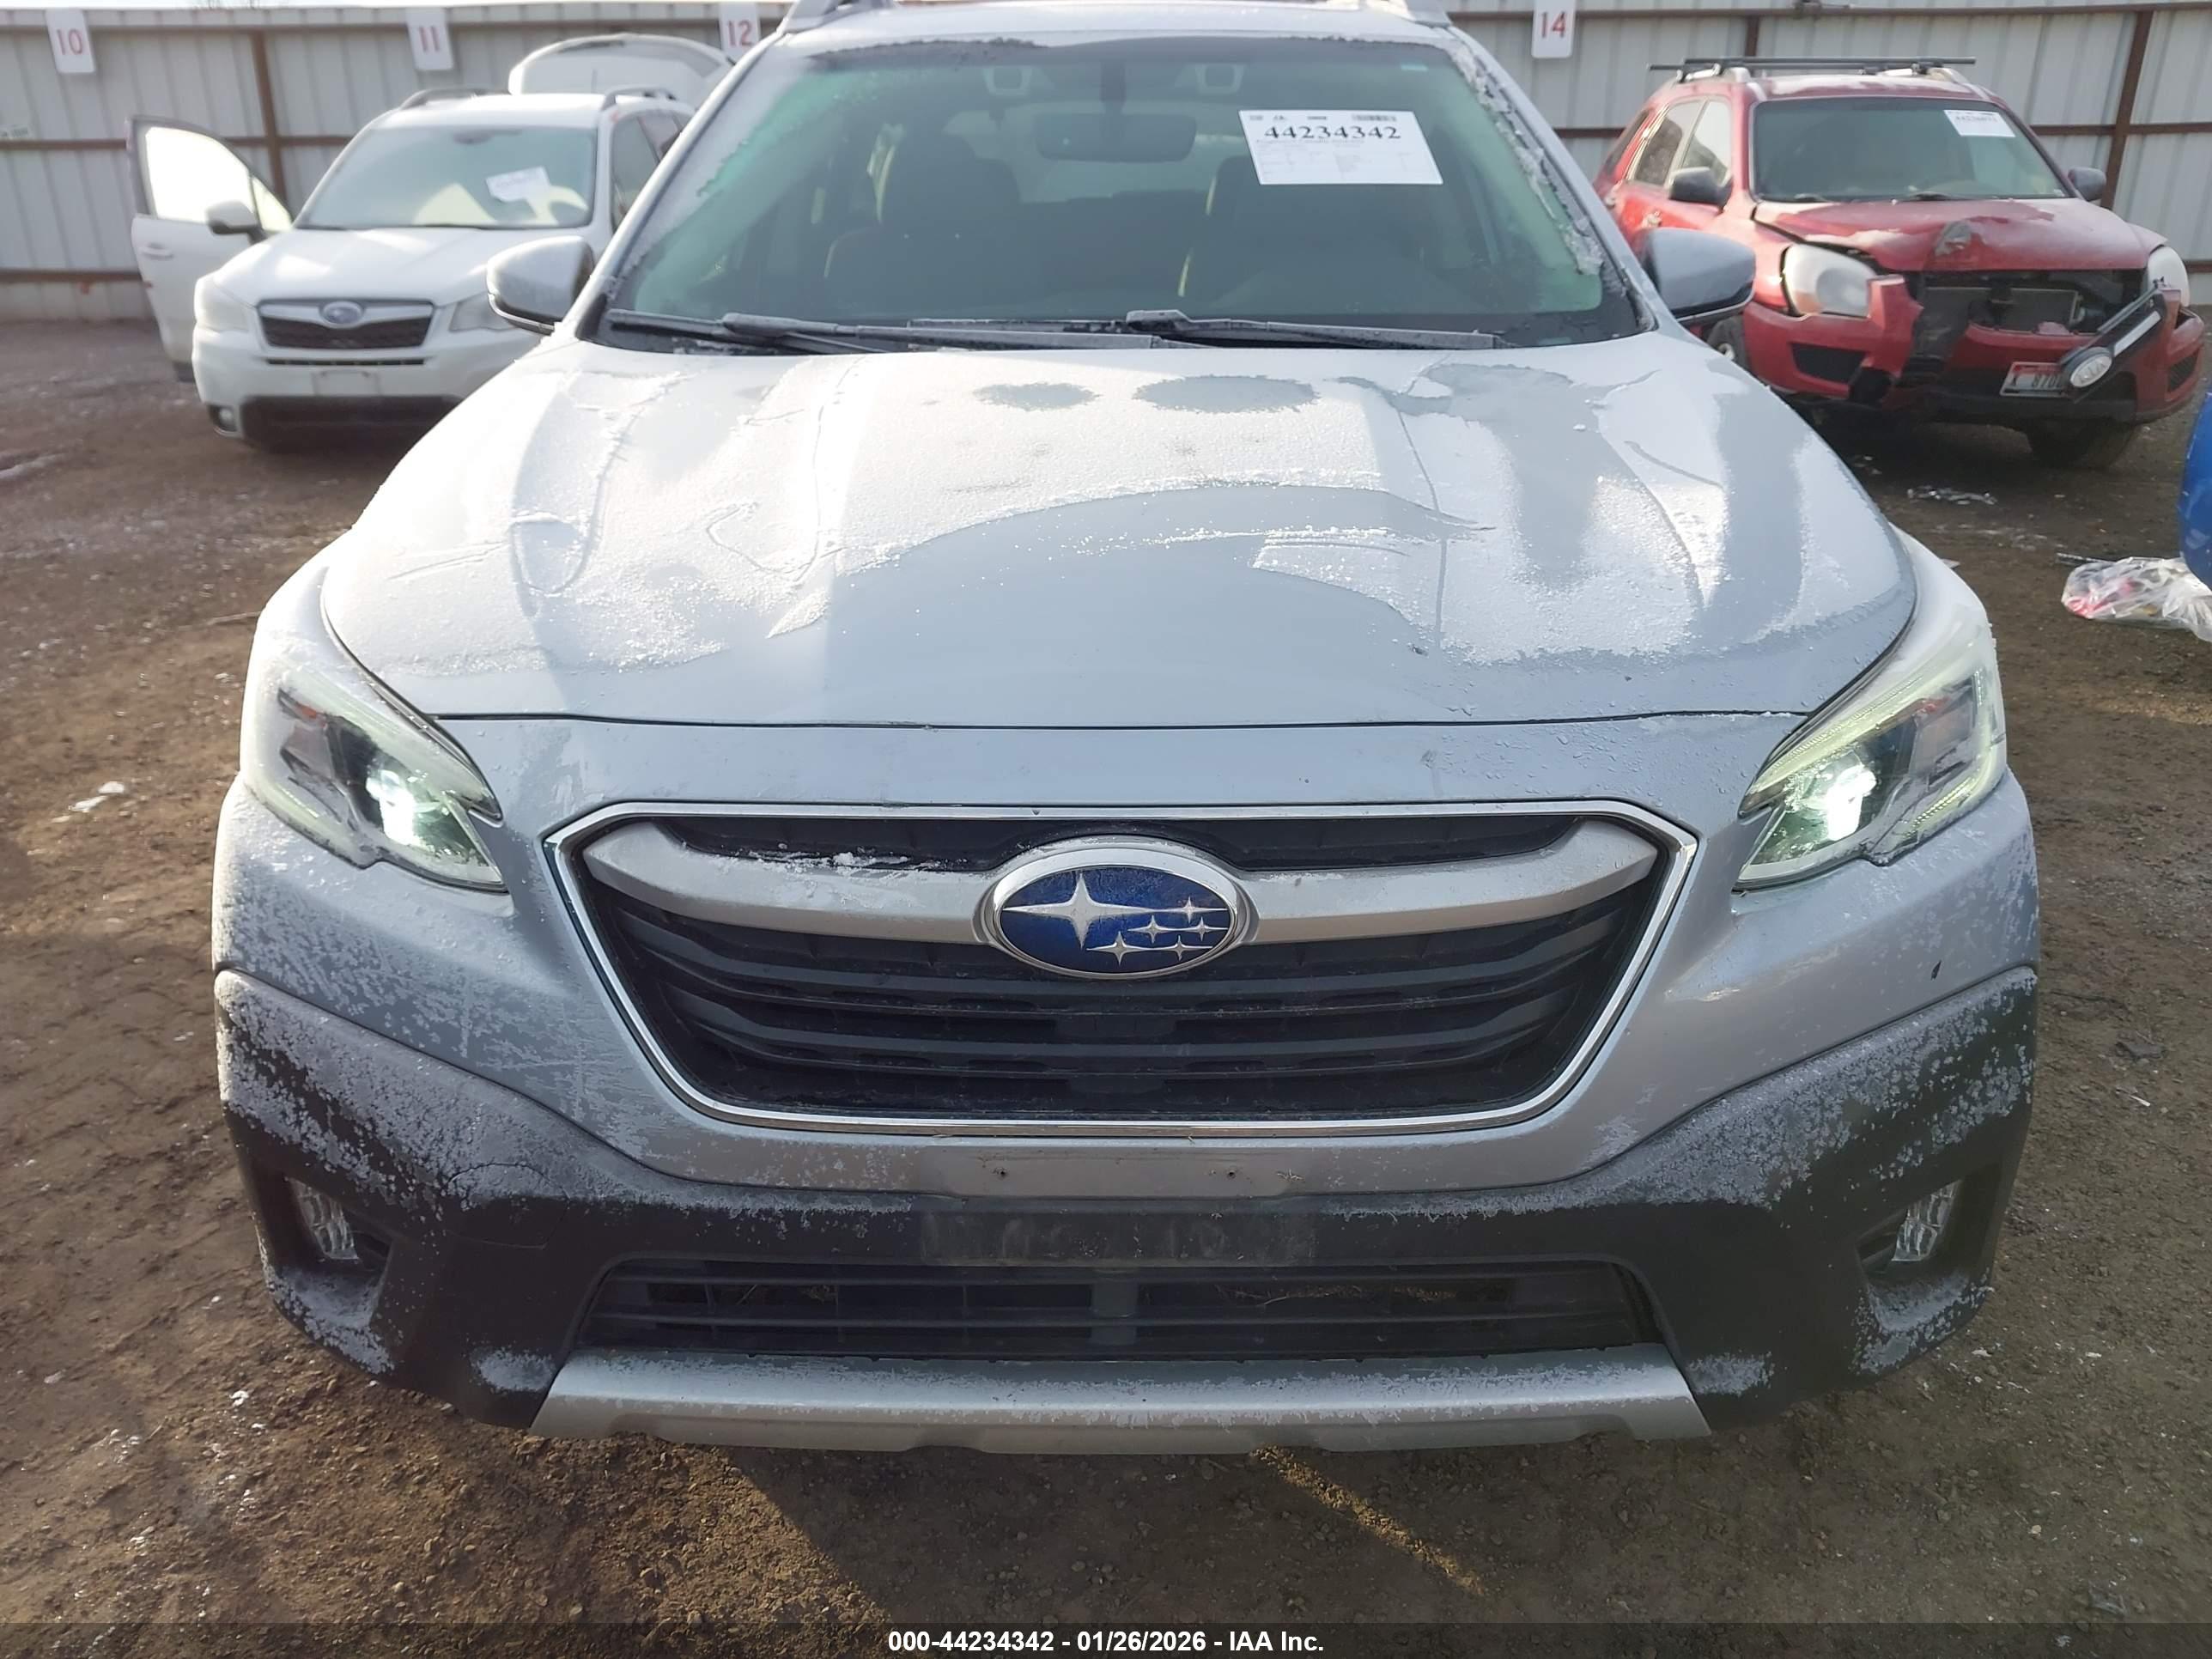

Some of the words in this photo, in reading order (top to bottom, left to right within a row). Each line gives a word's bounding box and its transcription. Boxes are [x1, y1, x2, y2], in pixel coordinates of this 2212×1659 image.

[418, 25, 440, 52] 11
[727, 20, 755, 46] 12
[1541, 11, 1565, 39] 14
[57, 28, 83, 56] 10
[1264, 125, 1401, 139] 44234342
